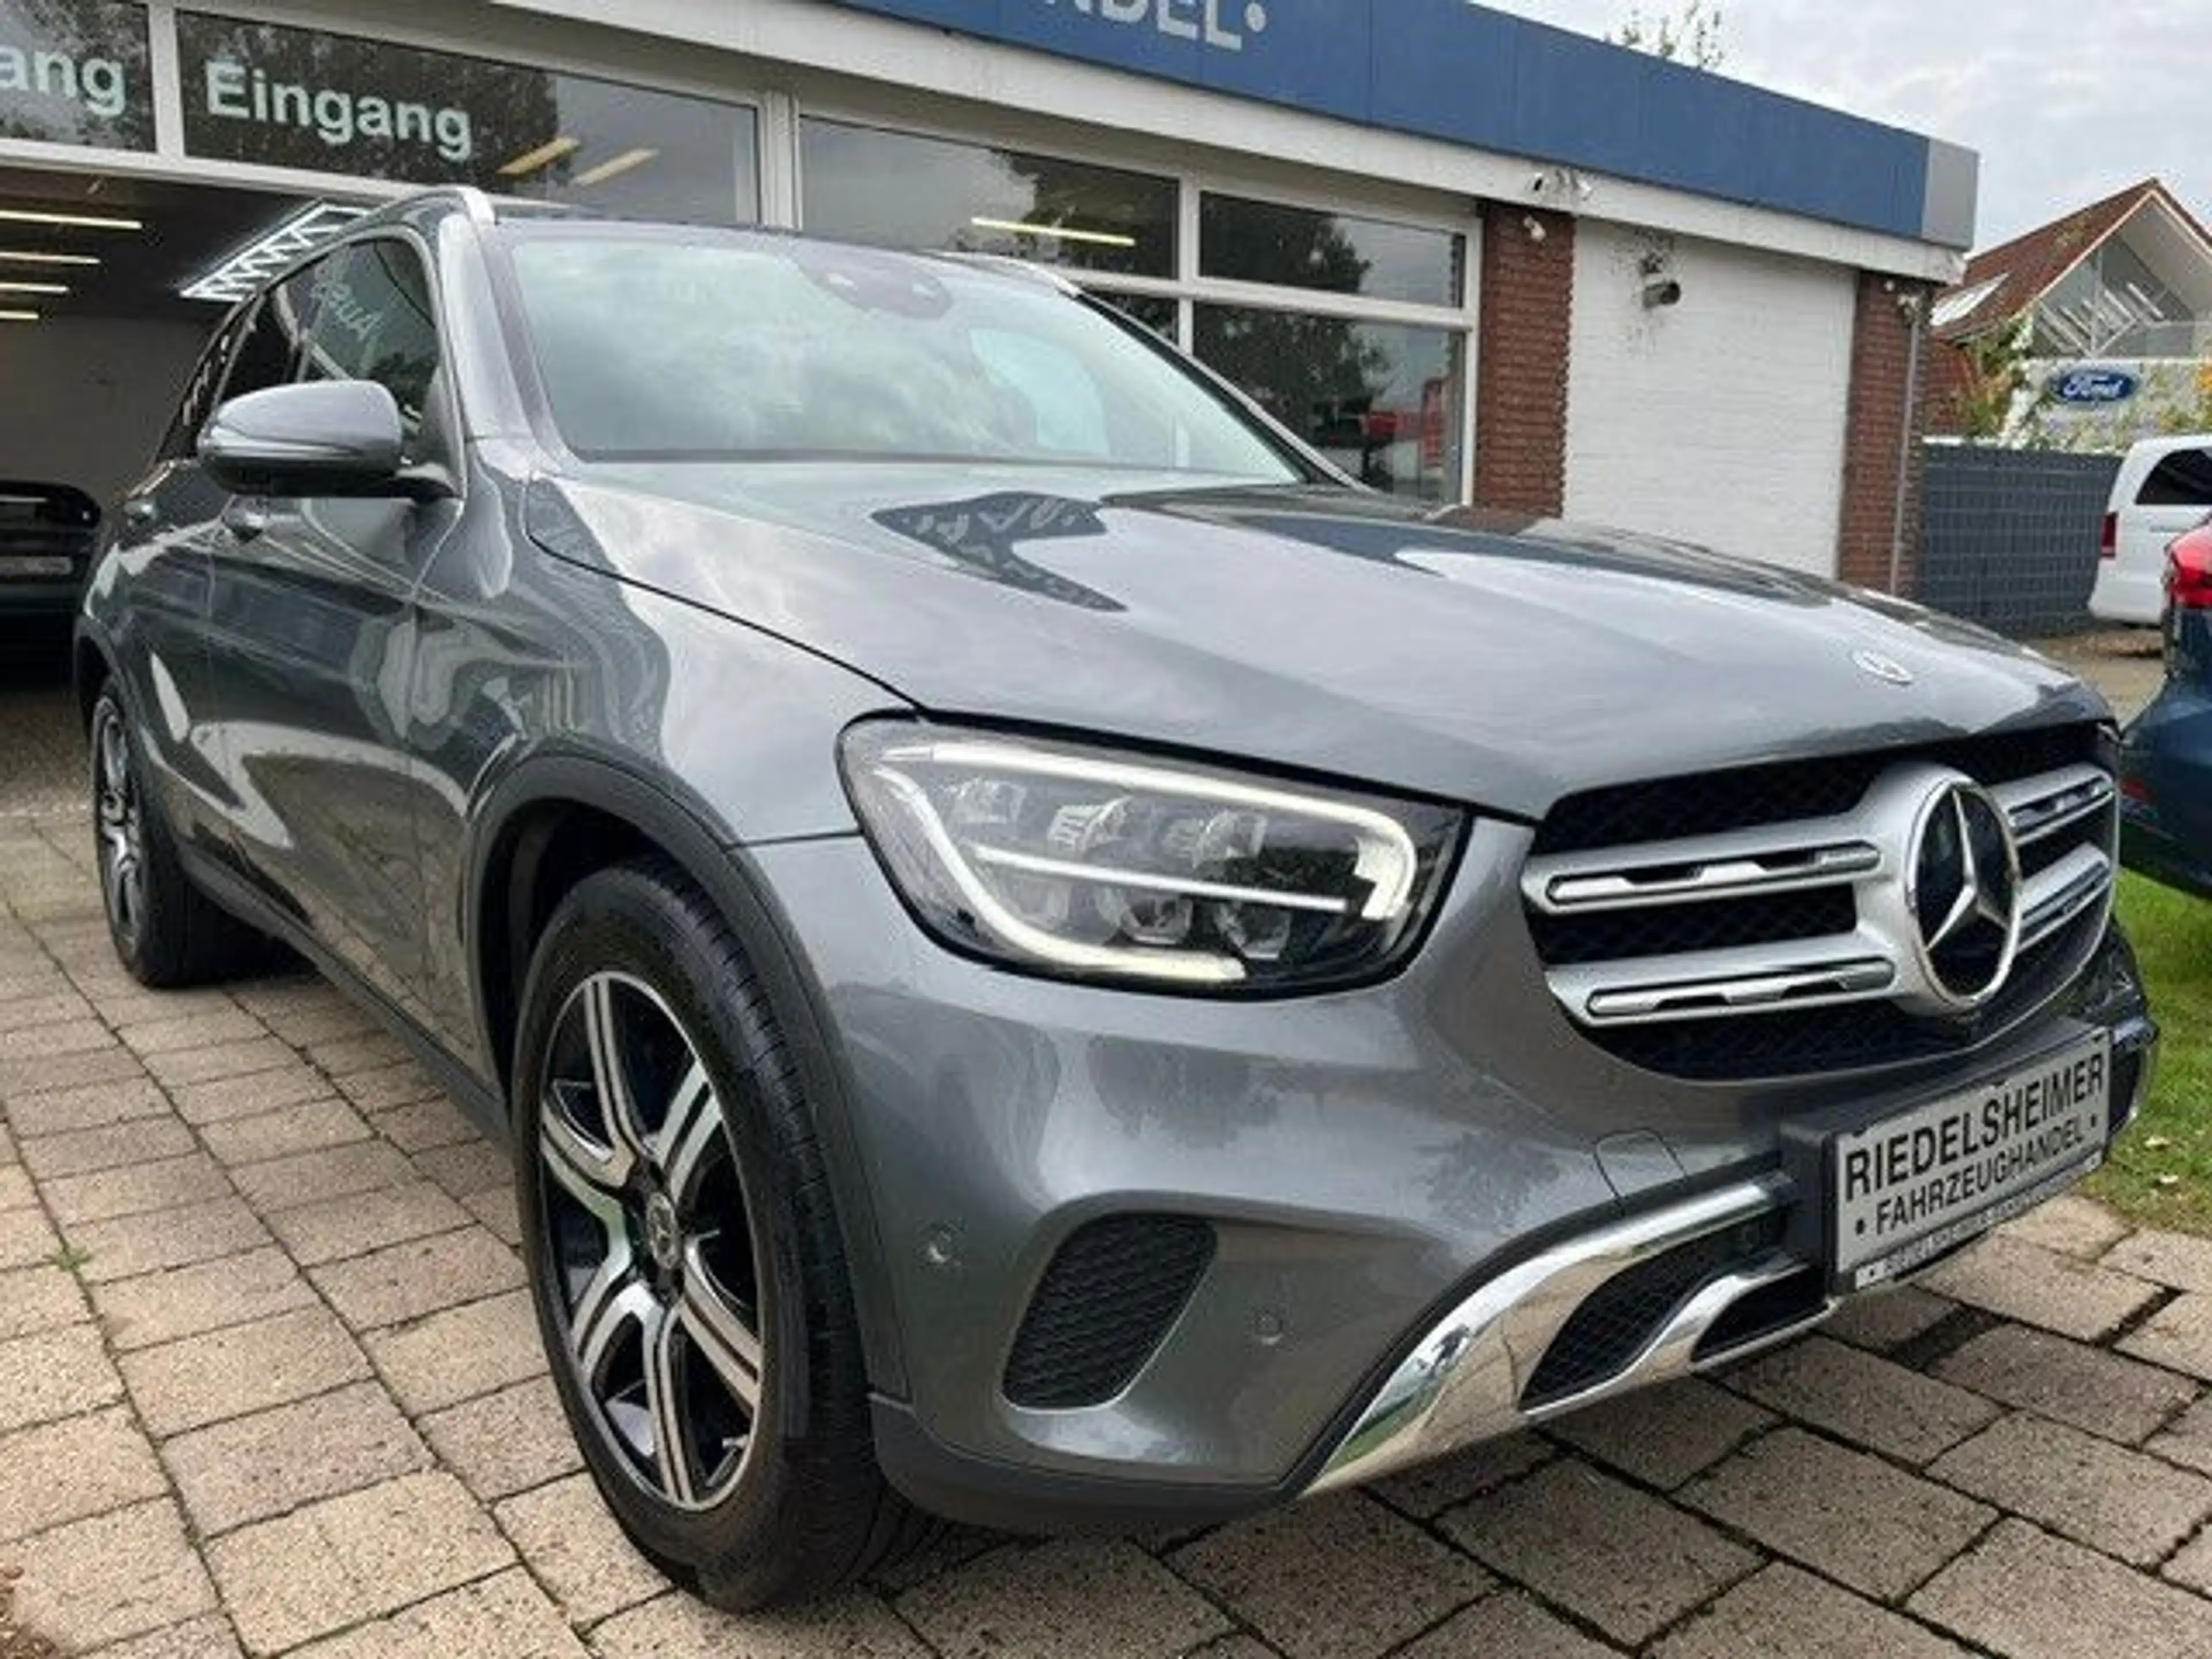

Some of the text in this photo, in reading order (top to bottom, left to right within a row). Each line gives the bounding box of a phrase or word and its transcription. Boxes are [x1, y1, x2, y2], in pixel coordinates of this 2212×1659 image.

[204, 59, 473, 162] Eingang
[1845, 1053, 2103, 1202] RIEDELSHEIMER
[1876, 1118, 2083, 1235] FAHRZEUGHANDEL
